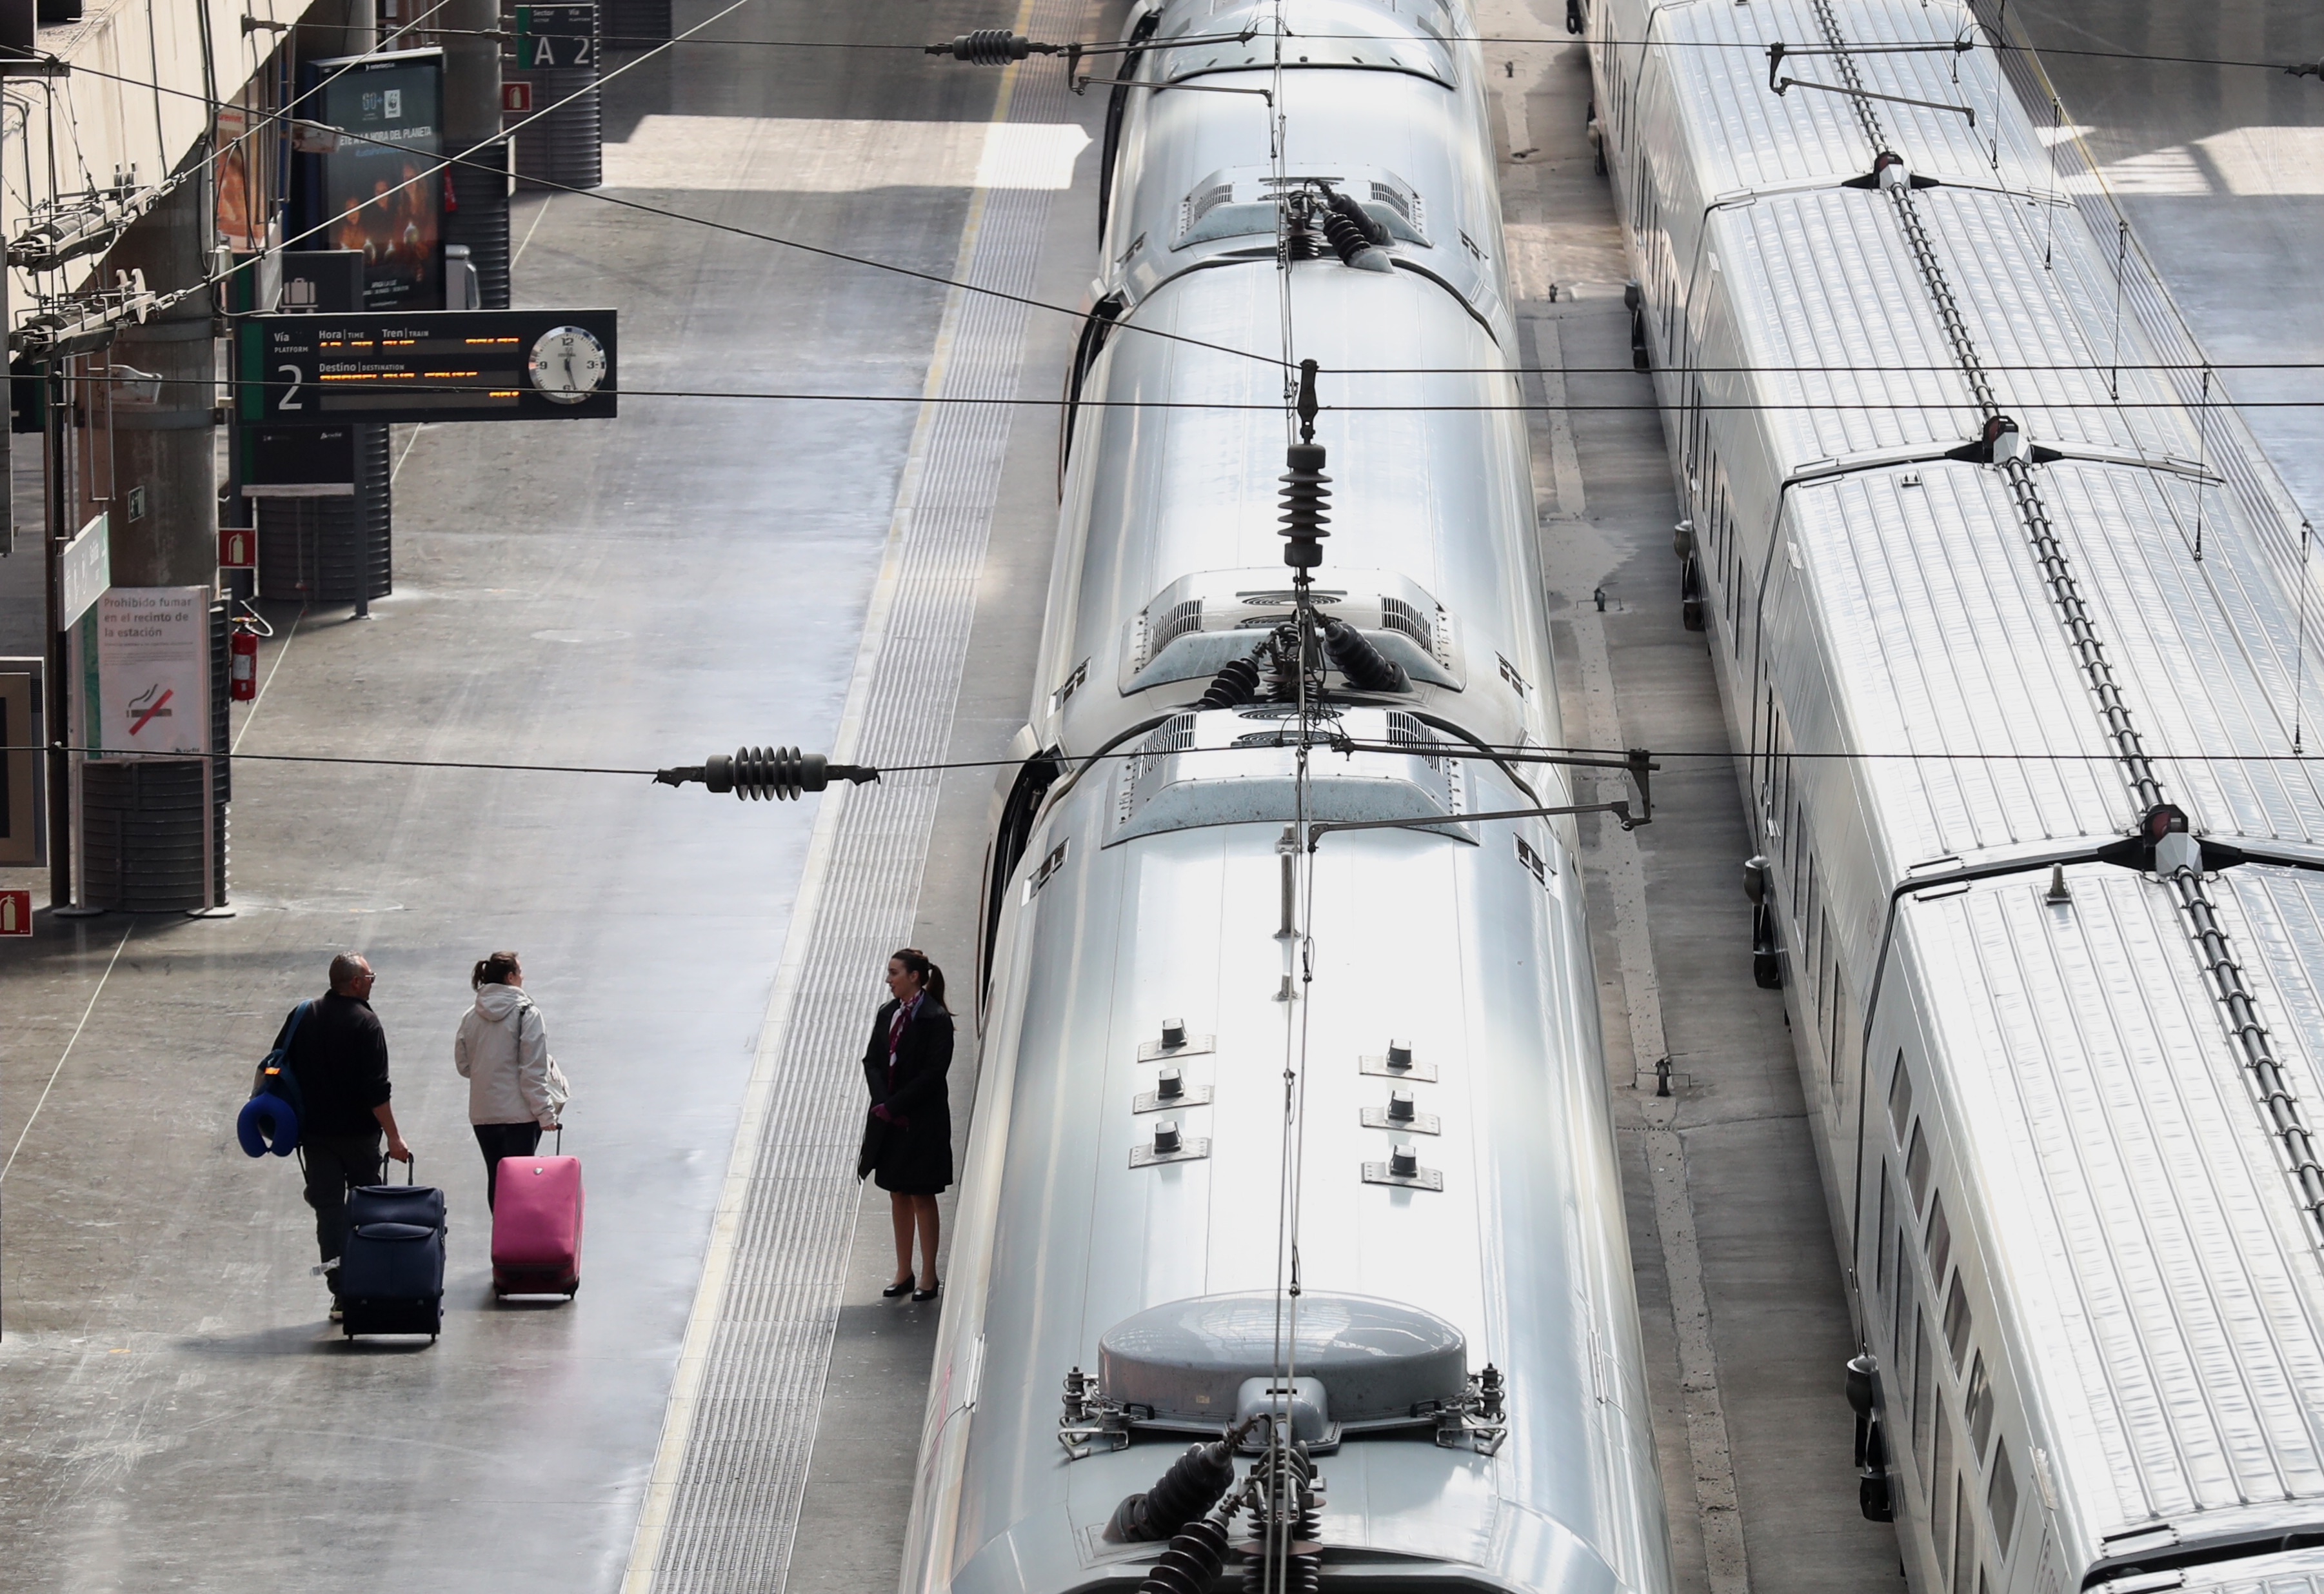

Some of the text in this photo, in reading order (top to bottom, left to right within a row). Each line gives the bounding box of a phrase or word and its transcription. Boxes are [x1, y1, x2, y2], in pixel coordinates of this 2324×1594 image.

[534, 37, 590, 65] A 2
[390, 130, 402, 140] DEL
[403, 126, 432, 138] PLANETA
[274, 332, 290, 342] Vía
[319, 330, 342, 339] Hora
[382, 328, 404, 338] Tren
[562, 337, 573, 346] 12
[539, 361, 595, 370] 9 3
[278, 364, 303, 410] 2
[104, 597, 192, 608] Prohibido fumar
[121, 613, 130, 623] el
[134, 613, 172, 623] recinto
[175, 612, 189, 621] de
[104, 628, 163, 637] la estación
